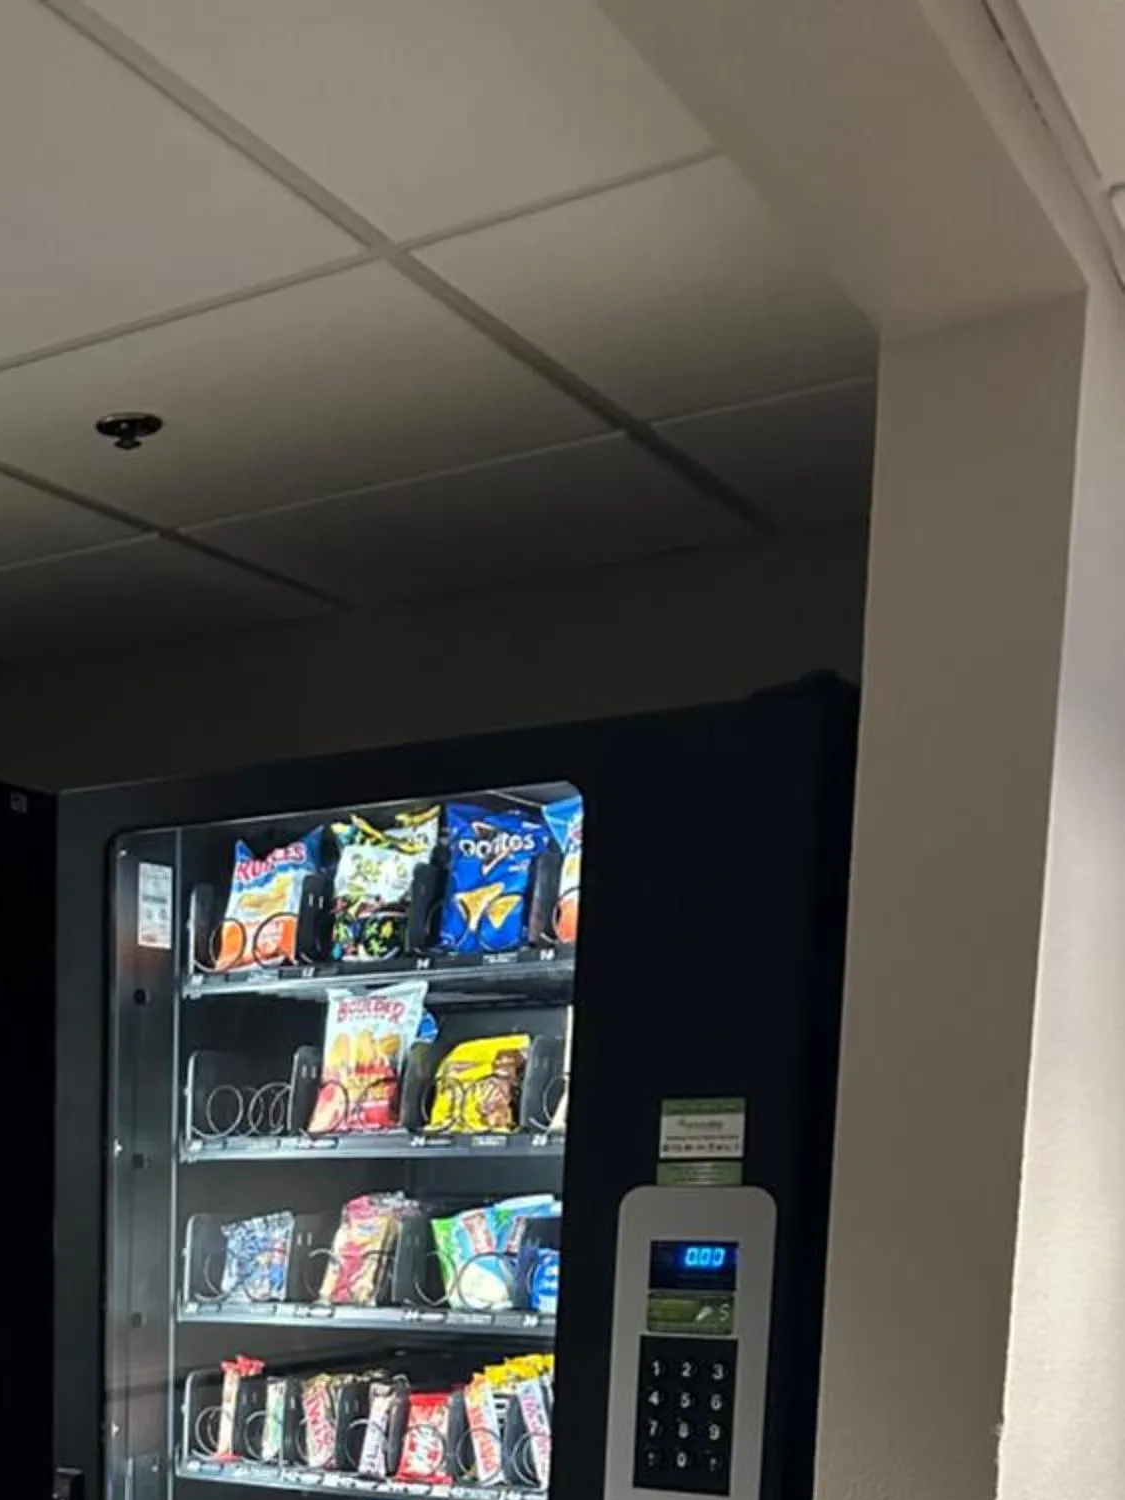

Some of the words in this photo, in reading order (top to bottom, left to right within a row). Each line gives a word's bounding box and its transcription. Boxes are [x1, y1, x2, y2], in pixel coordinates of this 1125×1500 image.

[652, 1360, 660, 1377] 1
[682, 1362, 692, 1377] 2
[712, 1363, 724, 1380] 3
[649, 1390, 660, 1406] 4
[680, 1392, 690, 1409] 5
[711, 1393, 722, 1411] 6
[650, 1420, 658, 1436] 7
[678, 1421, 689, 1439] 8
[709, 1423, 720, 1440] 9
[677, 1451, 687, 1468] 0
